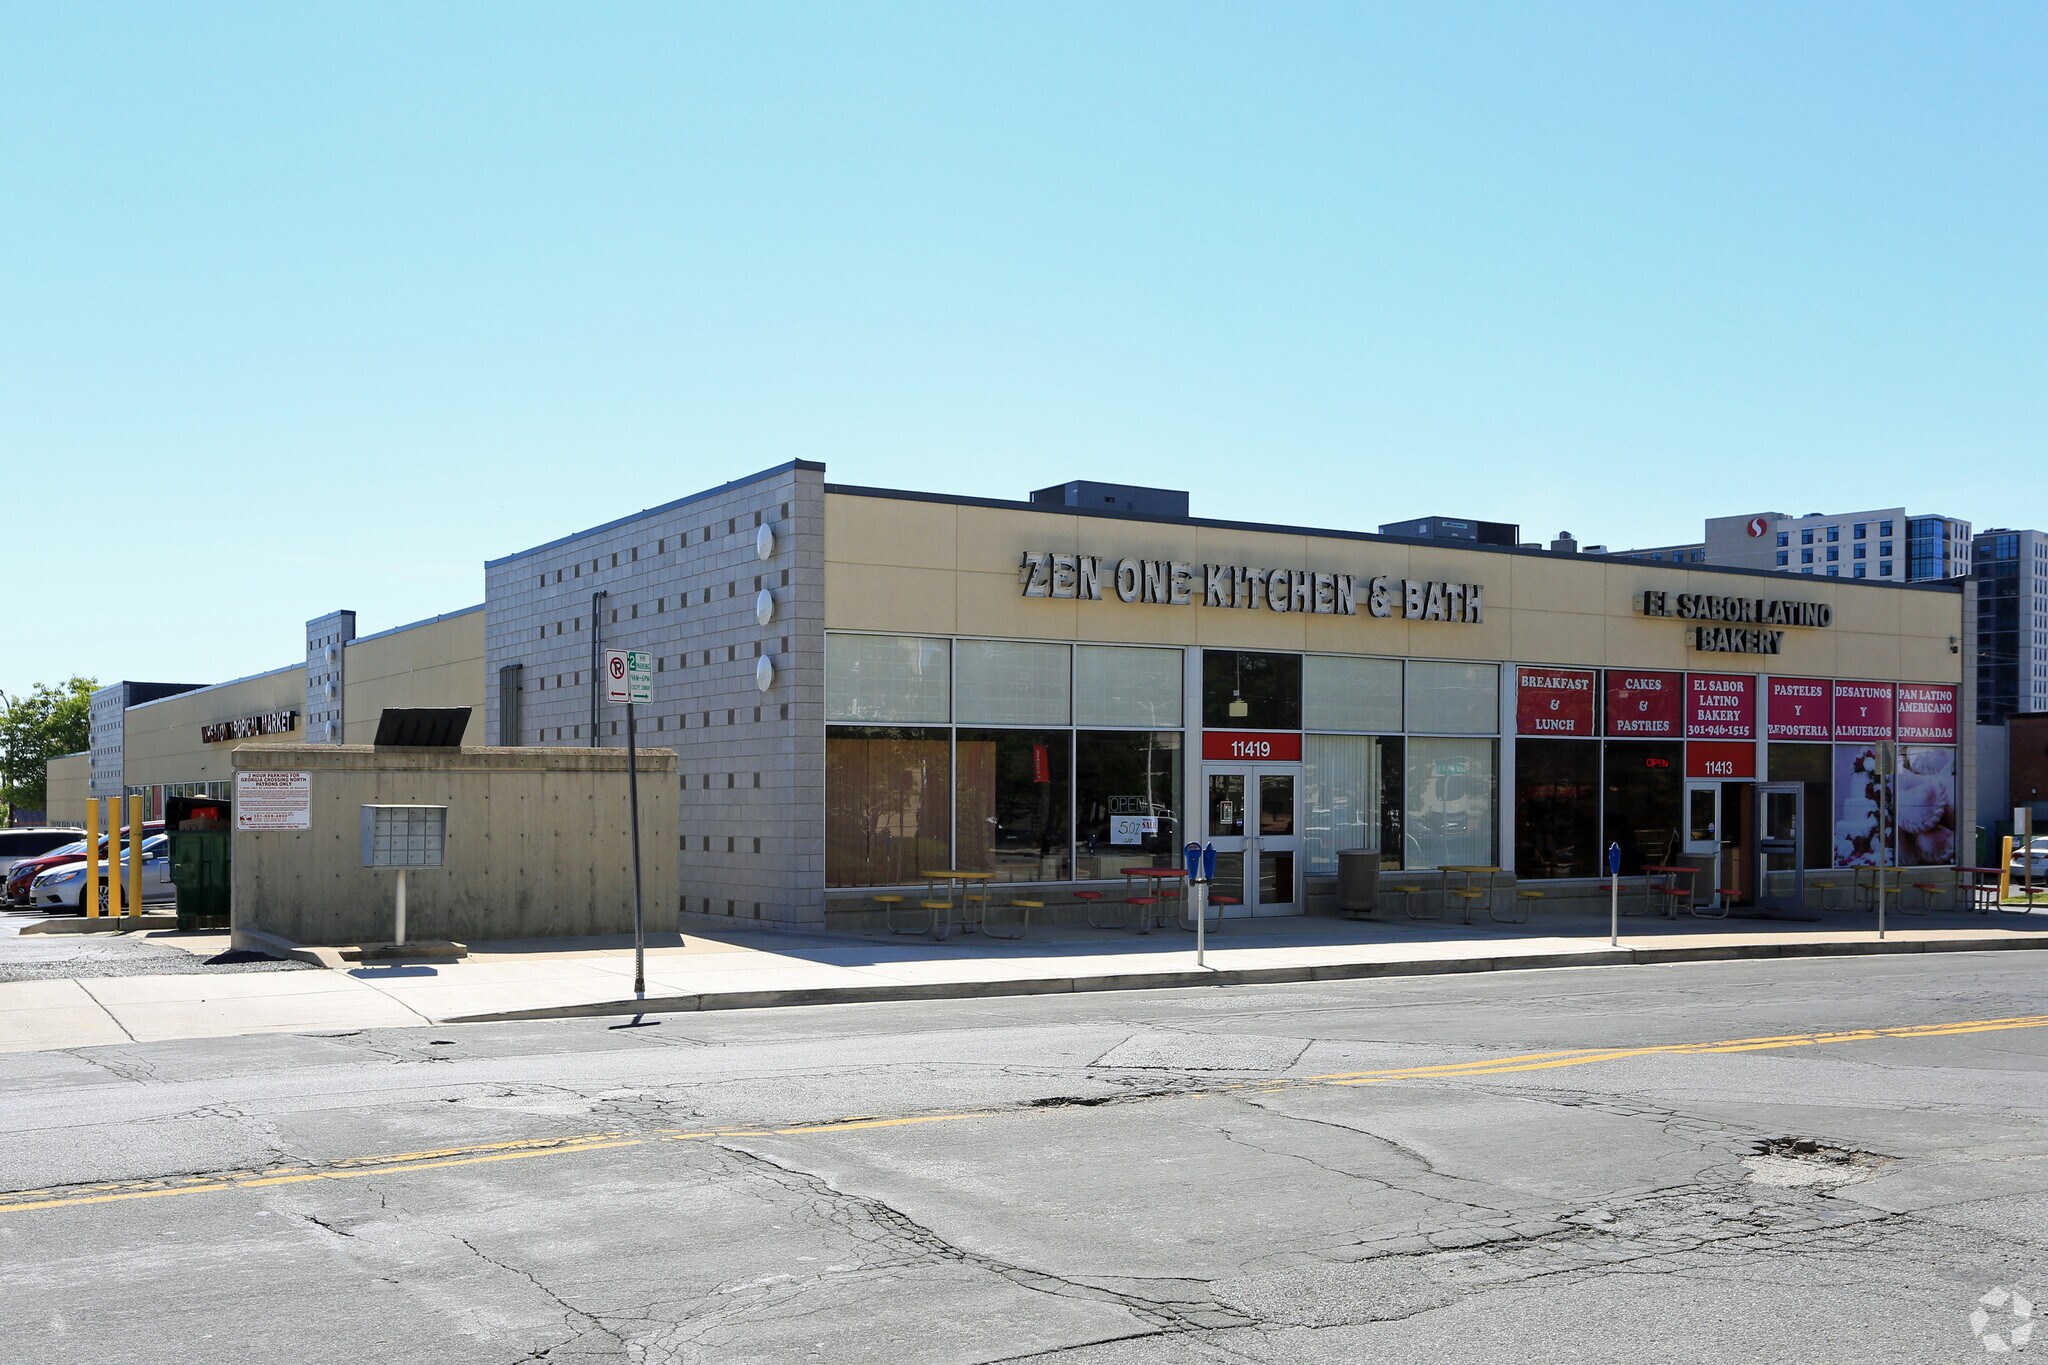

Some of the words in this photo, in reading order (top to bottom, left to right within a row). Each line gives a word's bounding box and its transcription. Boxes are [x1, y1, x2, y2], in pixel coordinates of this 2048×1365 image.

[1021, 550, 1103, 600] ZEN
[1114, 556, 1192, 605] ONE
[1202, 563, 1357, 615] KITCHEN
[1368, 575, 1392, 618] &
[1401, 578, 1484, 624] BATH
[1644, 590, 1676, 617] EL
[1677, 592, 1756, 622] SABOR
[1756, 599, 1834, 628] LATINO
[1695, 626, 1785, 655] BAKERY
[630, 655, 636, 668] 2
[1521, 675, 1589, 690] BREAKFAST
[1625, 678, 1662, 690] CAKES
[1693, 679, 1707, 691] EL
[1709, 680, 1744, 692] SABOR
[1774, 684, 1823, 697] PASTELES
[1835, 686, 1892, 699] DESAYUNOS
[1899, 689, 1918, 700] PAN
[1919, 690, 1953, 701] LATINO
[1550, 699, 1560, 711] &
[1639, 700, 1648, 711] &
[1699, 695, 1739, 707] LATINO
[1794, 705, 1802, 716] Y
[1860, 706, 1868, 717] Y
[1898, 702, 1953, 714] AMERICANO
[1697, 709, 1741, 721] BAKERY
[261, 710, 292, 735] MARKET
[1535, 718, 1575, 731] LUNCH
[1617, 719, 1670, 731] PASTRIES
[1688, 725, 1750, 736] 301-946-1515
[1768, 724, 1829, 736] REPOSTERIA
[1835, 725, 1892, 737] ALMUERZOS
[1898, 726, 1953, 738] ENPANADAS
[1231, 740, 1271, 757] 11419
[1646, 758, 1669, 768] OPEN
[1705, 761, 1733, 775] 11413
[1110, 797, 1145, 812] OPEN
